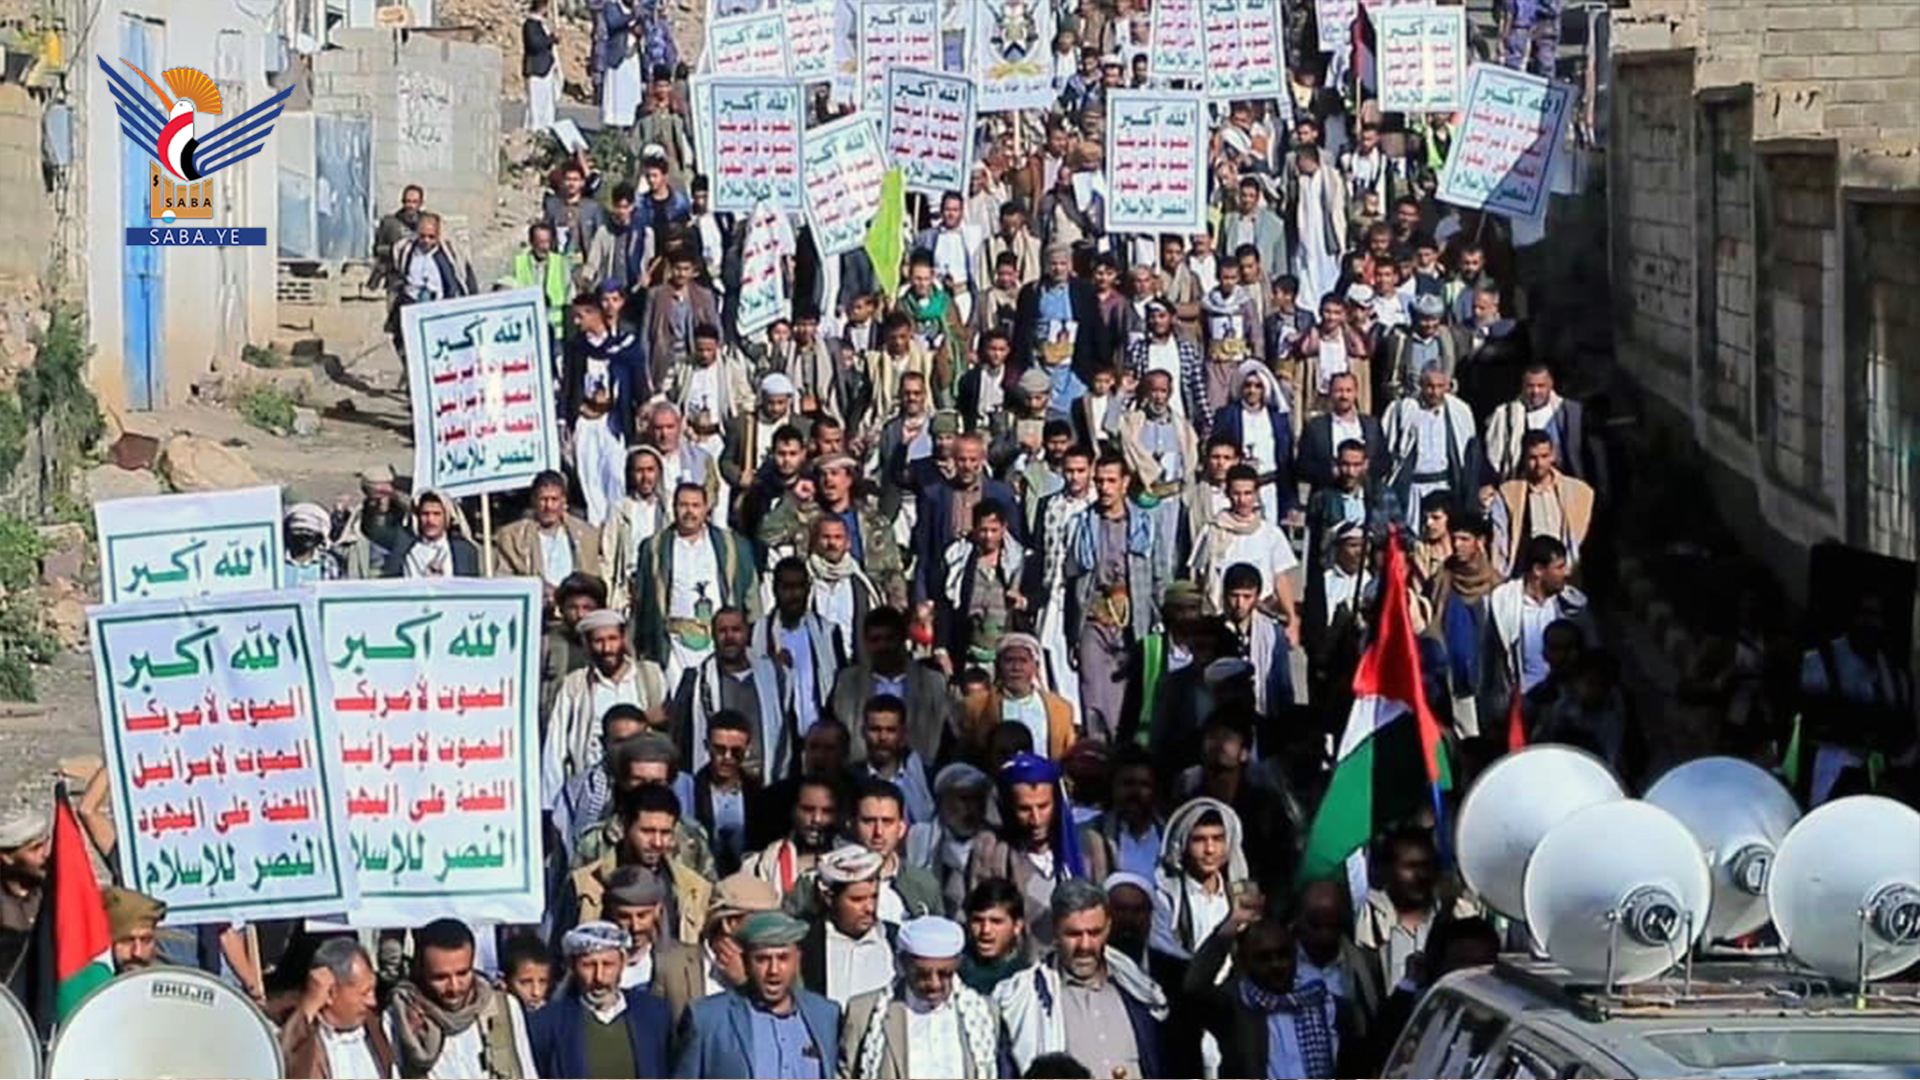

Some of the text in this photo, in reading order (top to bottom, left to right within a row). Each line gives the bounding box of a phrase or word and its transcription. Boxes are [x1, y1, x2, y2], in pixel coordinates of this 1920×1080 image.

[432, 314, 532, 361] الله أكبر
[121, 536, 267, 597] الله أكبر
[117, 620, 298, 693] الله أكبر
[330, 606, 516, 675] الله أكبر
[123, 686, 303, 735] الموت لأمريكا
[334, 675, 513, 719] الموت لأمريك
[132, 739, 311, 788] الموت لإسرائيل
[438, 727, 513, 769] الموت
[138, 787, 319, 839] اللعنة على اليهود
[409, 783, 445, 821] على
[456, 779, 514, 811] اللعنة
[146, 833, 326, 897] النصر للإسلام
[349, 824, 516, 887] النصر للإسلا
